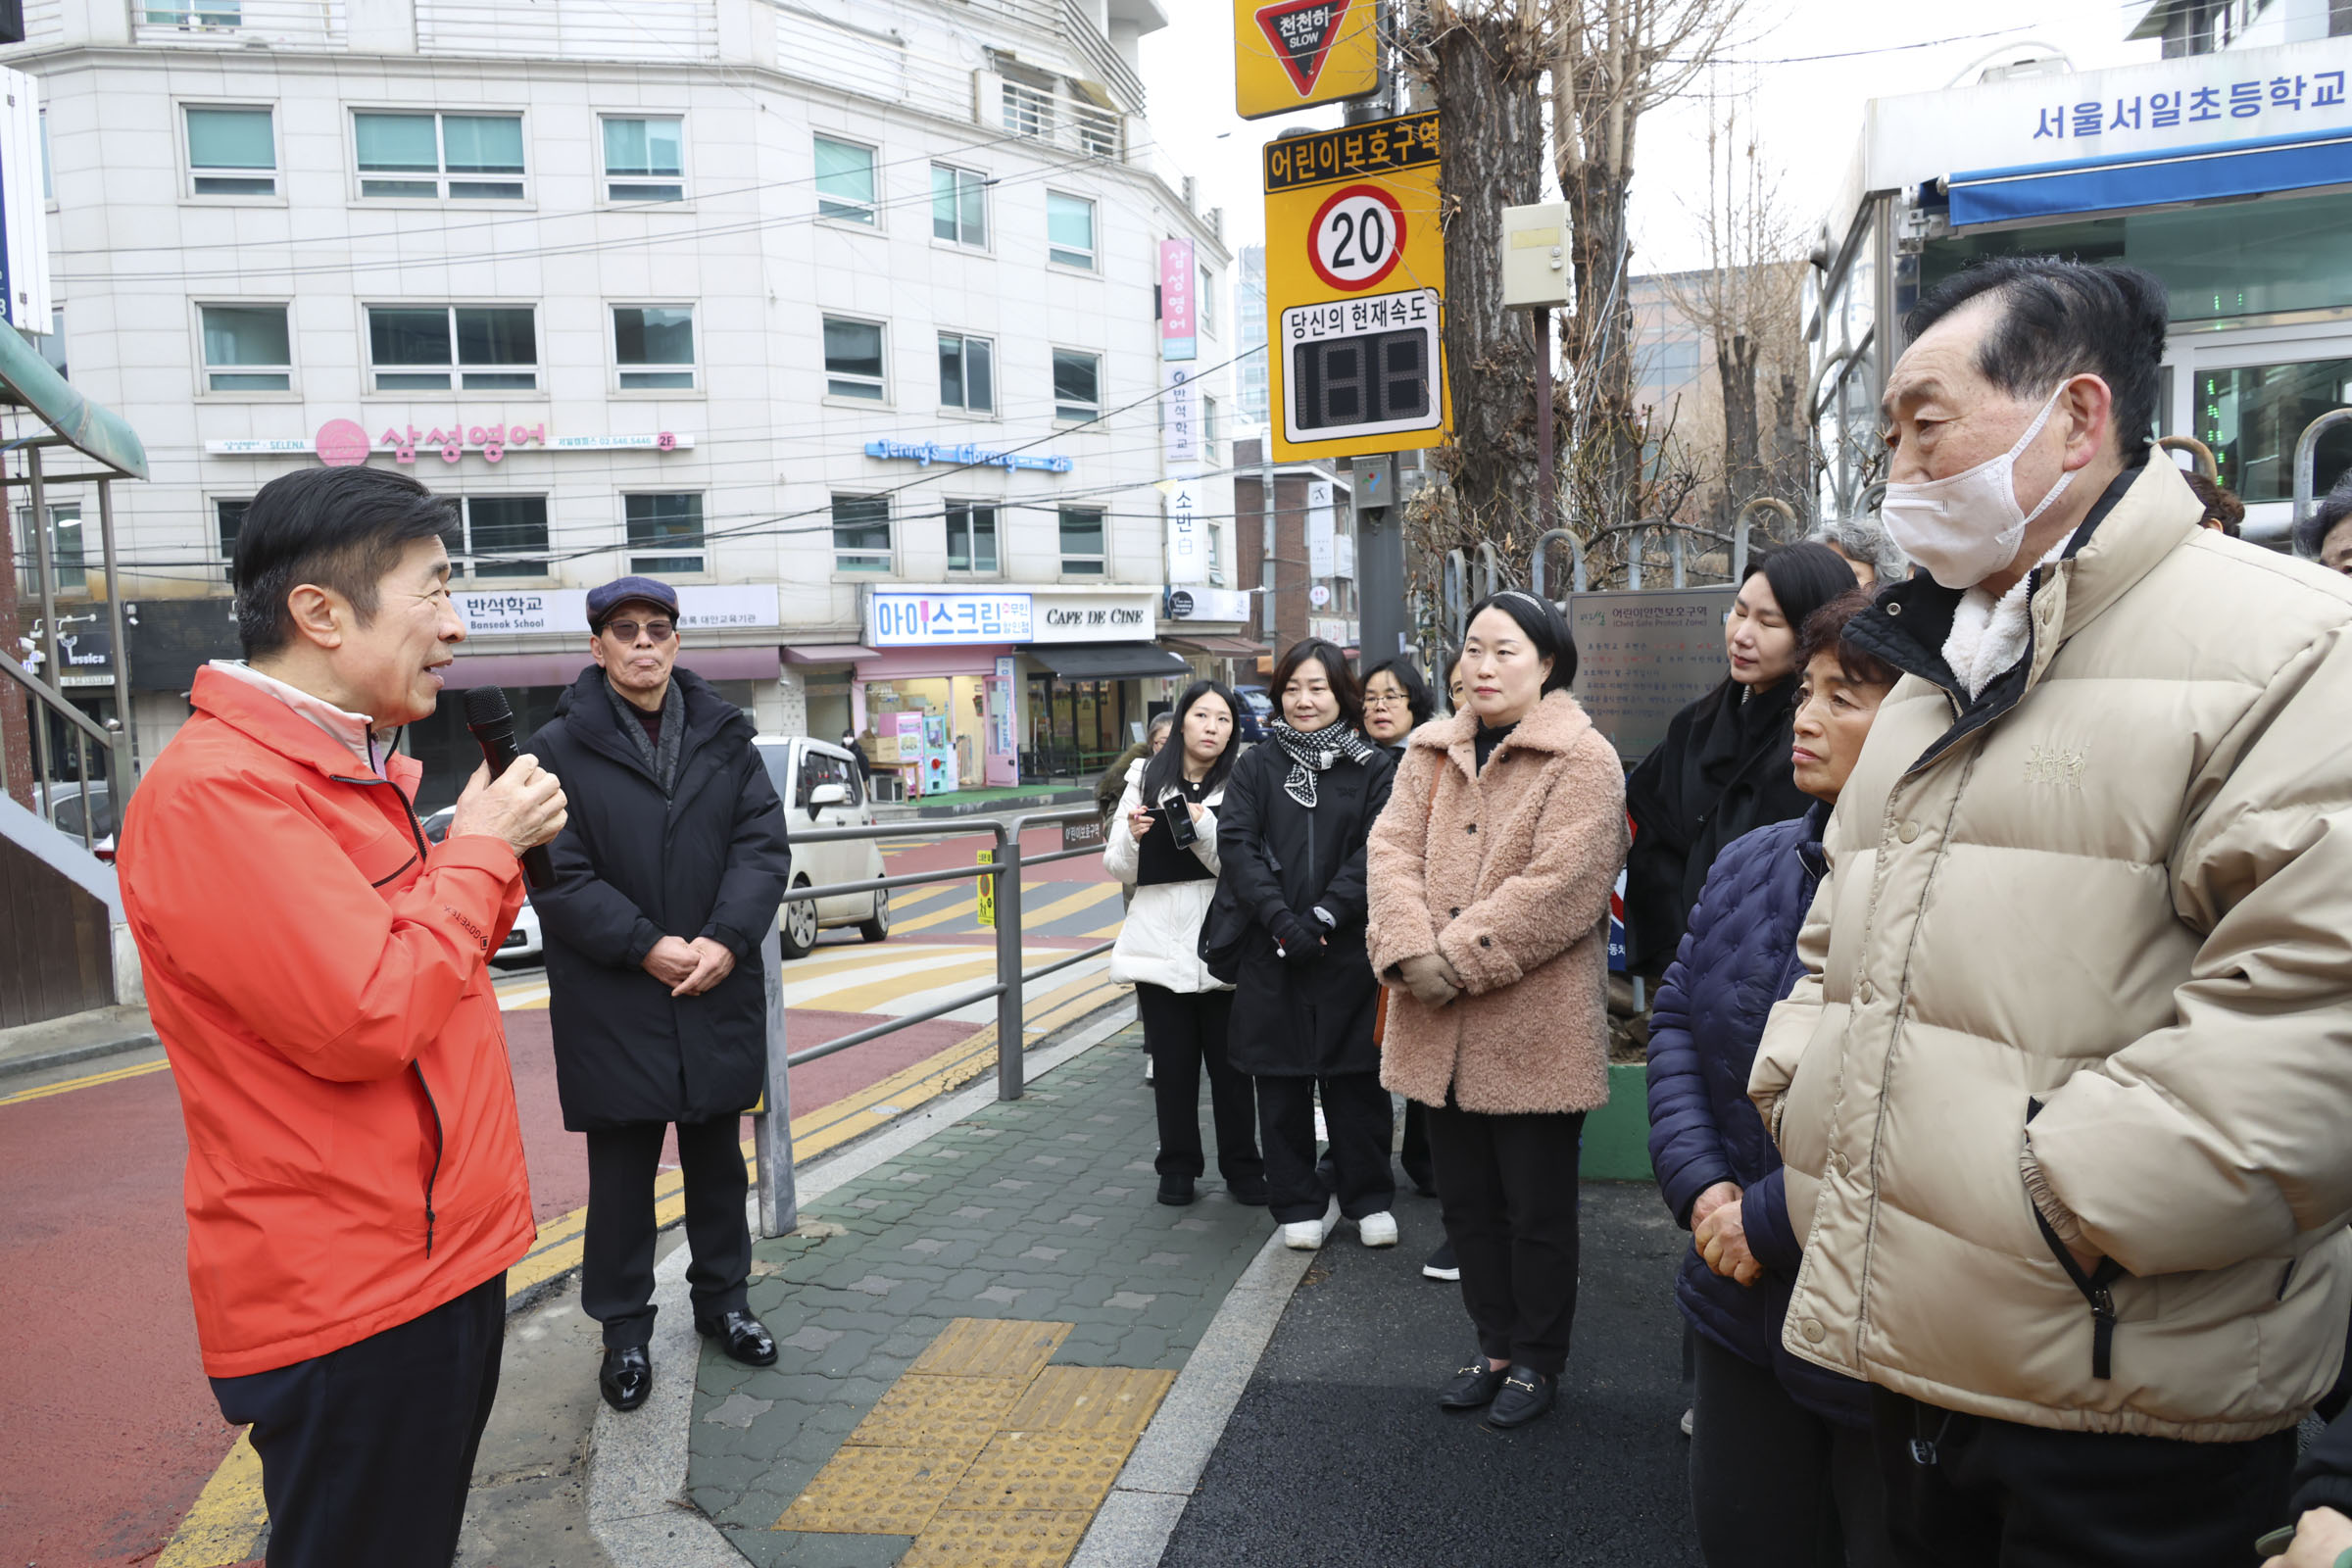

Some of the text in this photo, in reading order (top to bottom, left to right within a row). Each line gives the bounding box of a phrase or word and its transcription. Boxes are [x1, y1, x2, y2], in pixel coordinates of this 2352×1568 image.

[1280, 7, 1329, 37] 천천히
[1290, 31, 1319, 48] SLOW
[2033, 71, 2345, 139] 서울서일초등학교
[1271, 117, 1440, 182] 어린이보호구역
[1331, 208, 1385, 269] 20
[1168, 250, 1187, 329] 삼성영어
[1291, 305, 1345, 339] 당신의
[1173, 389, 1188, 449] 반석학교
[270, 440, 305, 451] SELENA
[380, 423, 545, 464] 삼성영어
[660, 435, 673, 447] 2F
[878, 439, 1069, 473] Jenny's Library 2F
[1176, 490, 1193, 533] 소번
[466, 596, 543, 616] 반석학교
[878, 601, 1001, 635] 아이스크림
[1010, 603, 1029, 617] 무인
[1088, 609, 1105, 625] DE
[1109, 608, 1144, 624] CINE
[470, 618, 544, 630] Banseok School
[1065, 823, 1101, 842] 어린이보호구역
[443, 904, 482, 939] GORE-TEX
